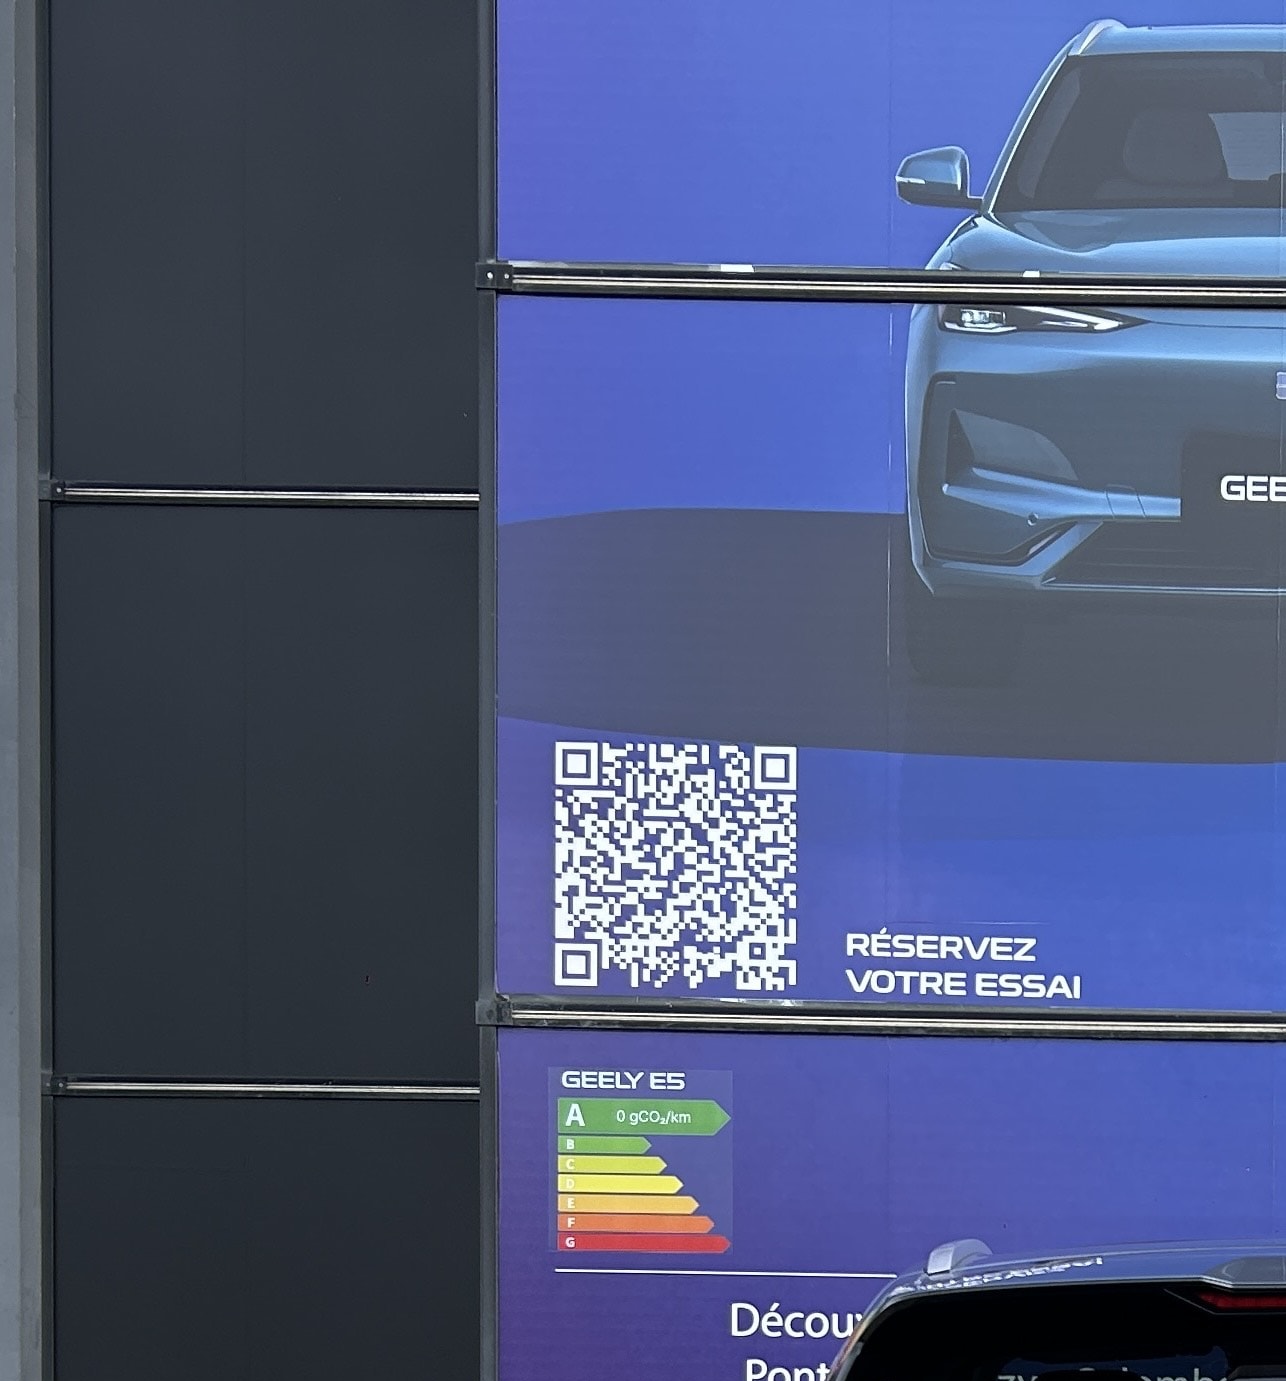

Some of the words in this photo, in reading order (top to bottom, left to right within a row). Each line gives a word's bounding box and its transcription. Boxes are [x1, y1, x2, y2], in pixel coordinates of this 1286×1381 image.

[846, 926, 1037, 962] RÉSERVEZ
[845, 969, 967, 996] VOTRE
[975, 973, 1082, 999] ESSAI
[561, 1071, 645, 1089] GEELY
[650, 1072, 686, 1091] E5
[565, 1103, 586, 1127] A
[616, 1109, 626, 1123] 0
[566, 1138, 575, 1150] B
[566, 1158, 576, 1170] C
[566, 1178, 575, 1189] D
[567, 1197, 576, 1209] E
[567, 1217, 576, 1228] F
[565, 1236, 576, 1248] G
[730, 1302, 862, 1338] Décou
